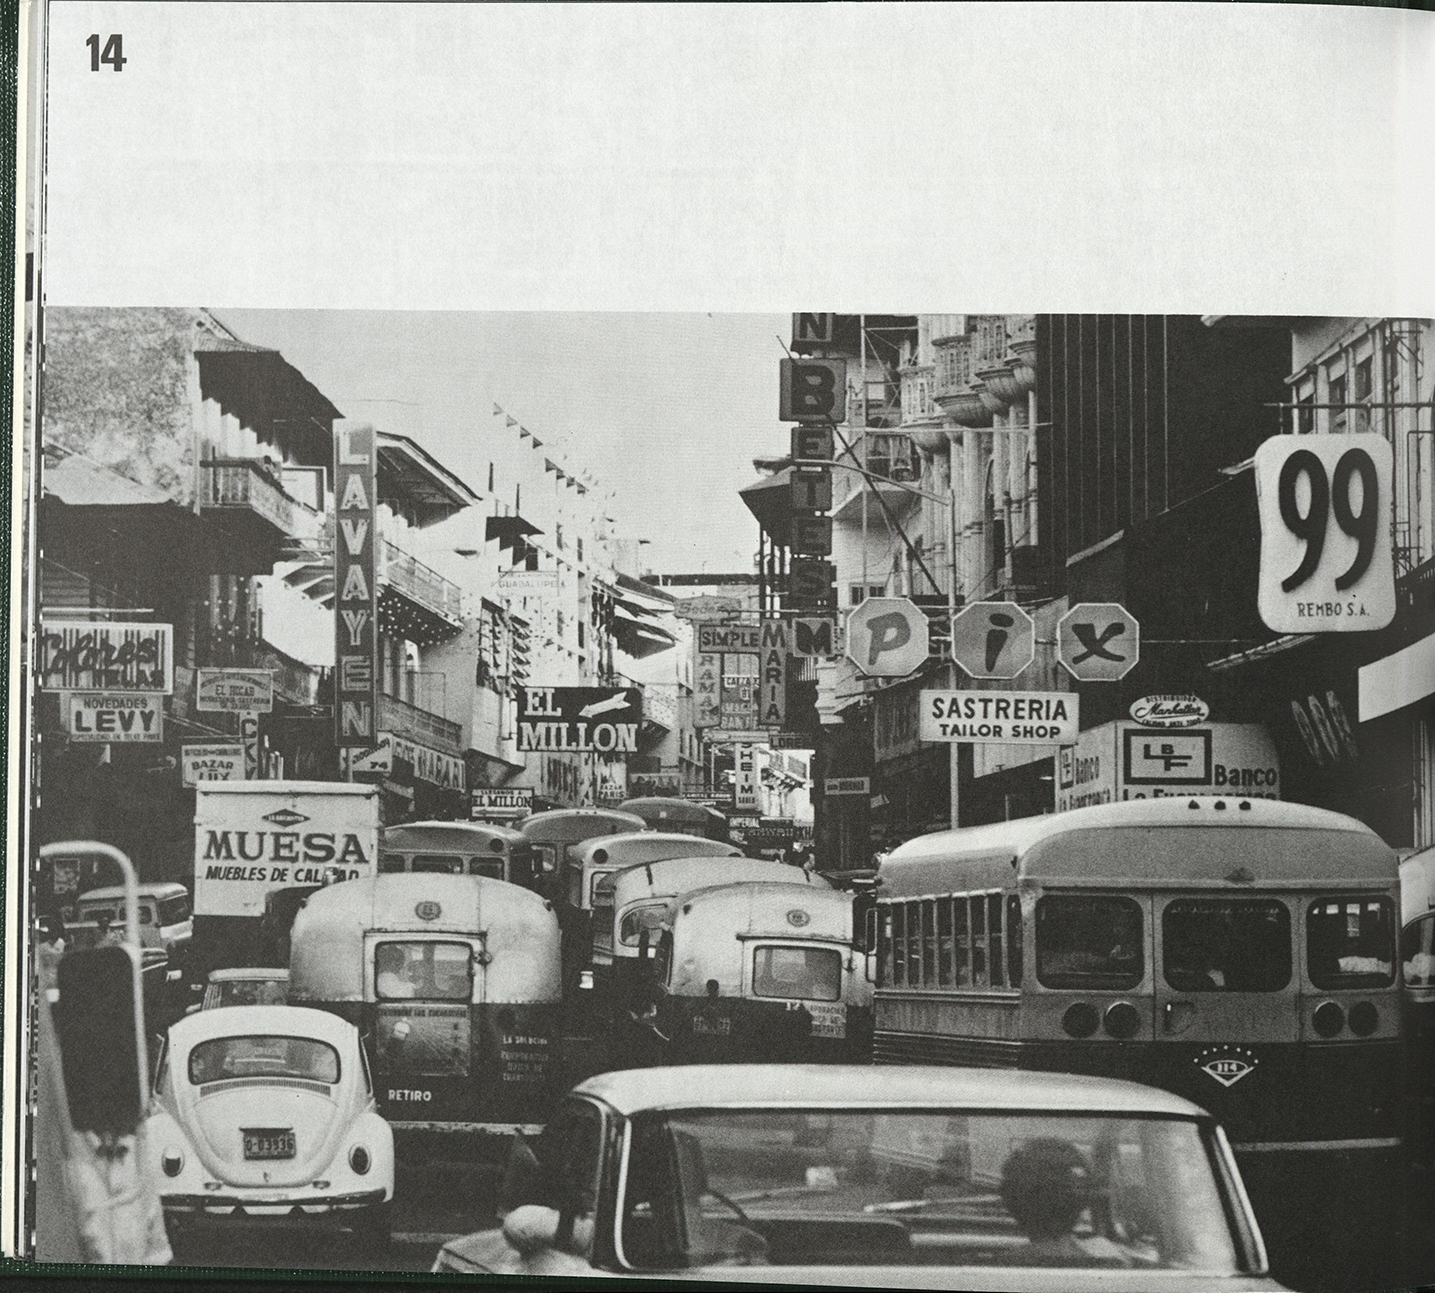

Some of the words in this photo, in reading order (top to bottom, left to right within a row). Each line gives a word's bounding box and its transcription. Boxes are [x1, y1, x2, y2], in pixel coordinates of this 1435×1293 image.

[86, 34, 127, 72] 14
[1279, 448, 1379, 593] 99
[339, 430, 372, 737] LAVAYEN
[1298, 603, 1342, 617] REMBO
[702, 631, 759, 647] SIMPLE
[762, 624, 786, 720] MARIA
[83, 698, 147, 709] NOVEDADES
[524, 688, 562, 716] EL
[932, 698, 1067, 720] SASTRERIA
[75, 710, 155, 732] LEVY
[940, 724, 1001, 738] TAILOR
[1012, 725, 1061, 739] SHOP
[519, 722, 639, 752] MILLON
[191, 760, 234, 771] BAZAR
[1214, 763, 1277, 787] Banco
[203, 830, 369, 864] MUESA
[206, 866, 266, 880] MUEBLES
[270, 868, 289, 882] DE
[388, 1089, 432, 1101] RETIRO
